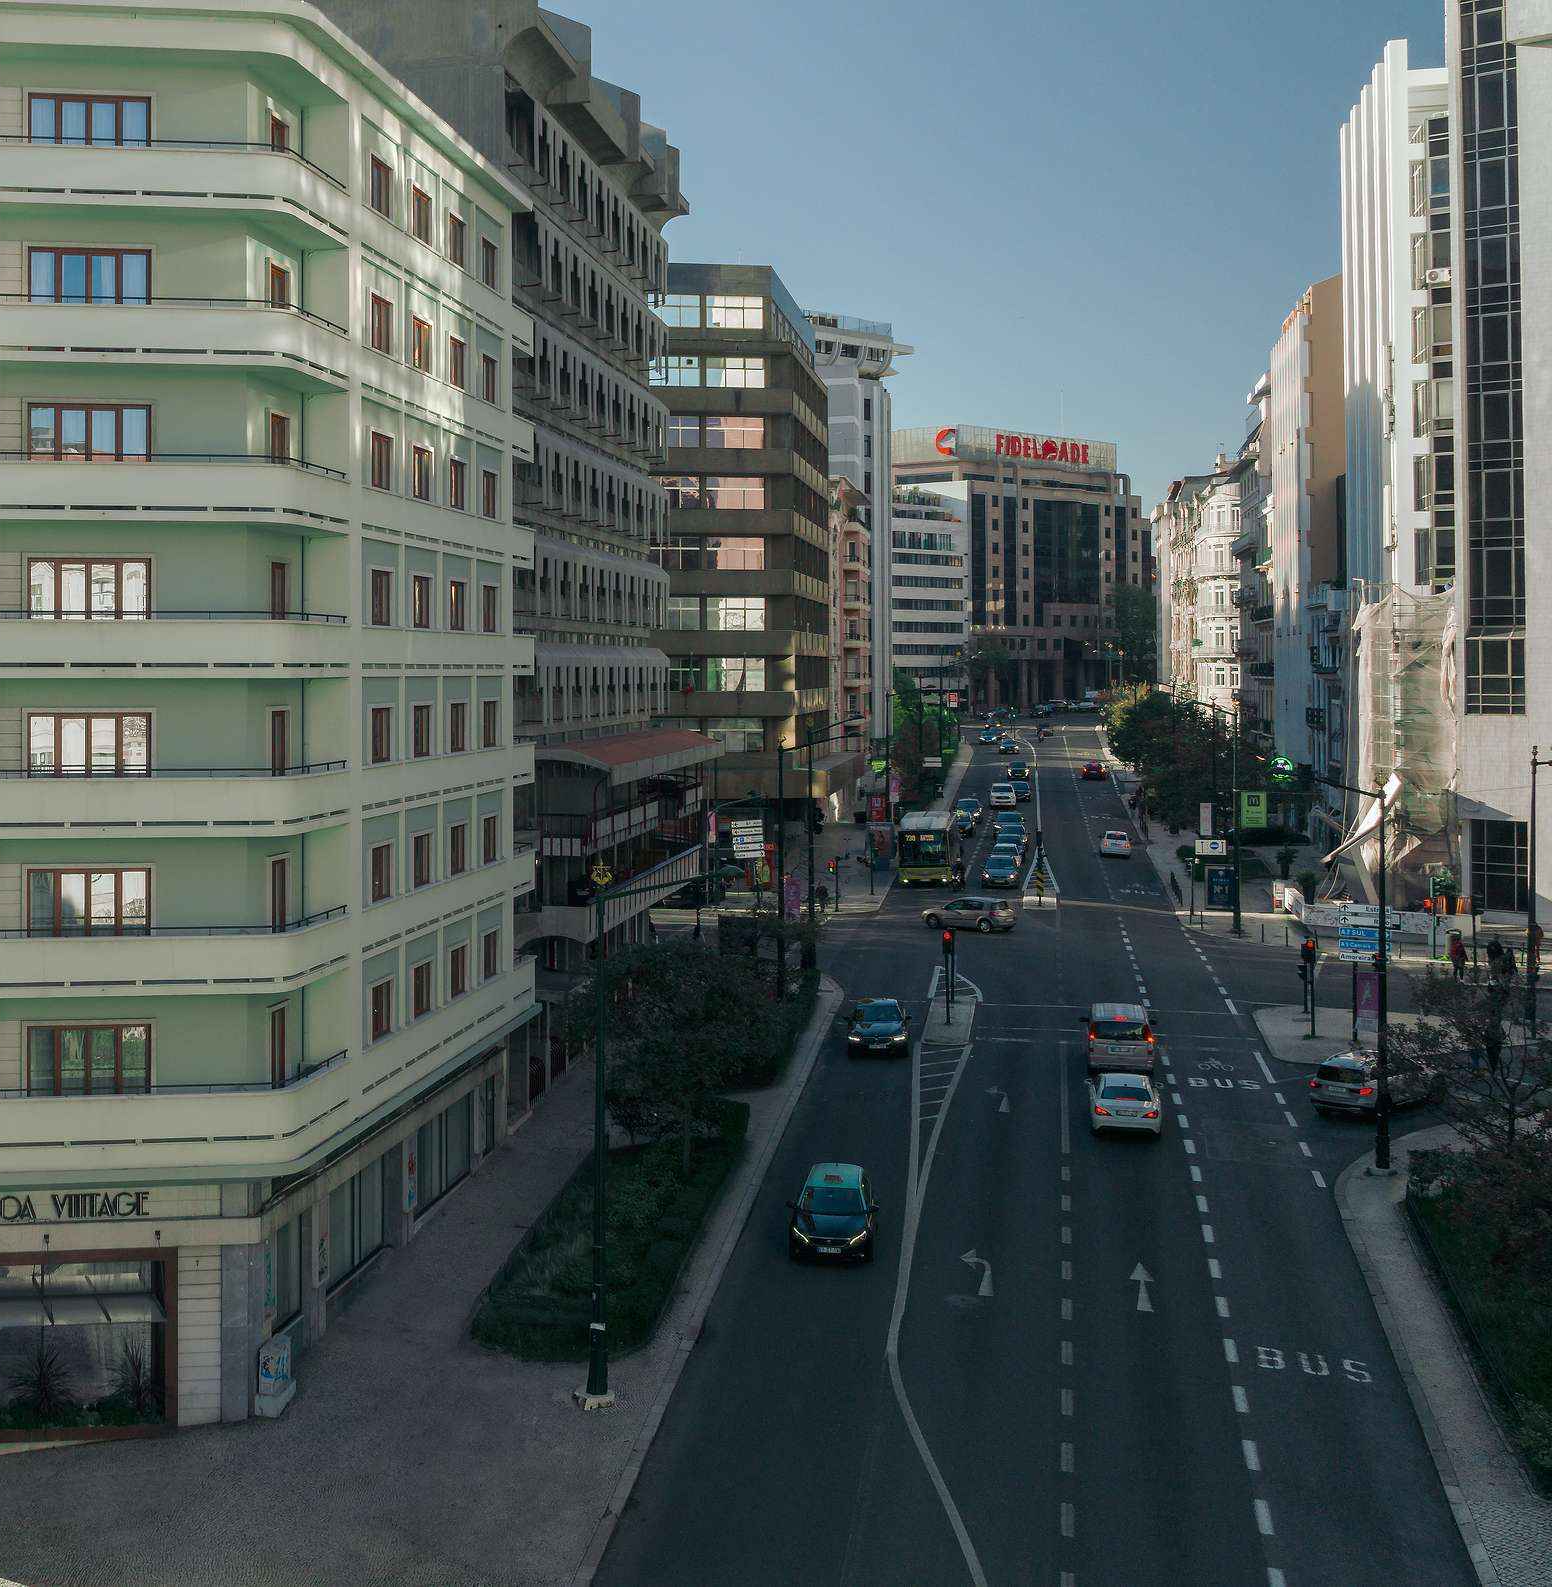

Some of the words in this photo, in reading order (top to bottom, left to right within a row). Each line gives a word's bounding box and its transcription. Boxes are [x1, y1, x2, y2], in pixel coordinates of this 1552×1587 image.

[1186, 1076, 1262, 1091] BUS
[51, 1191, 150, 1218] VINTAGE
[1255, 1345, 1373, 1383] BUS
